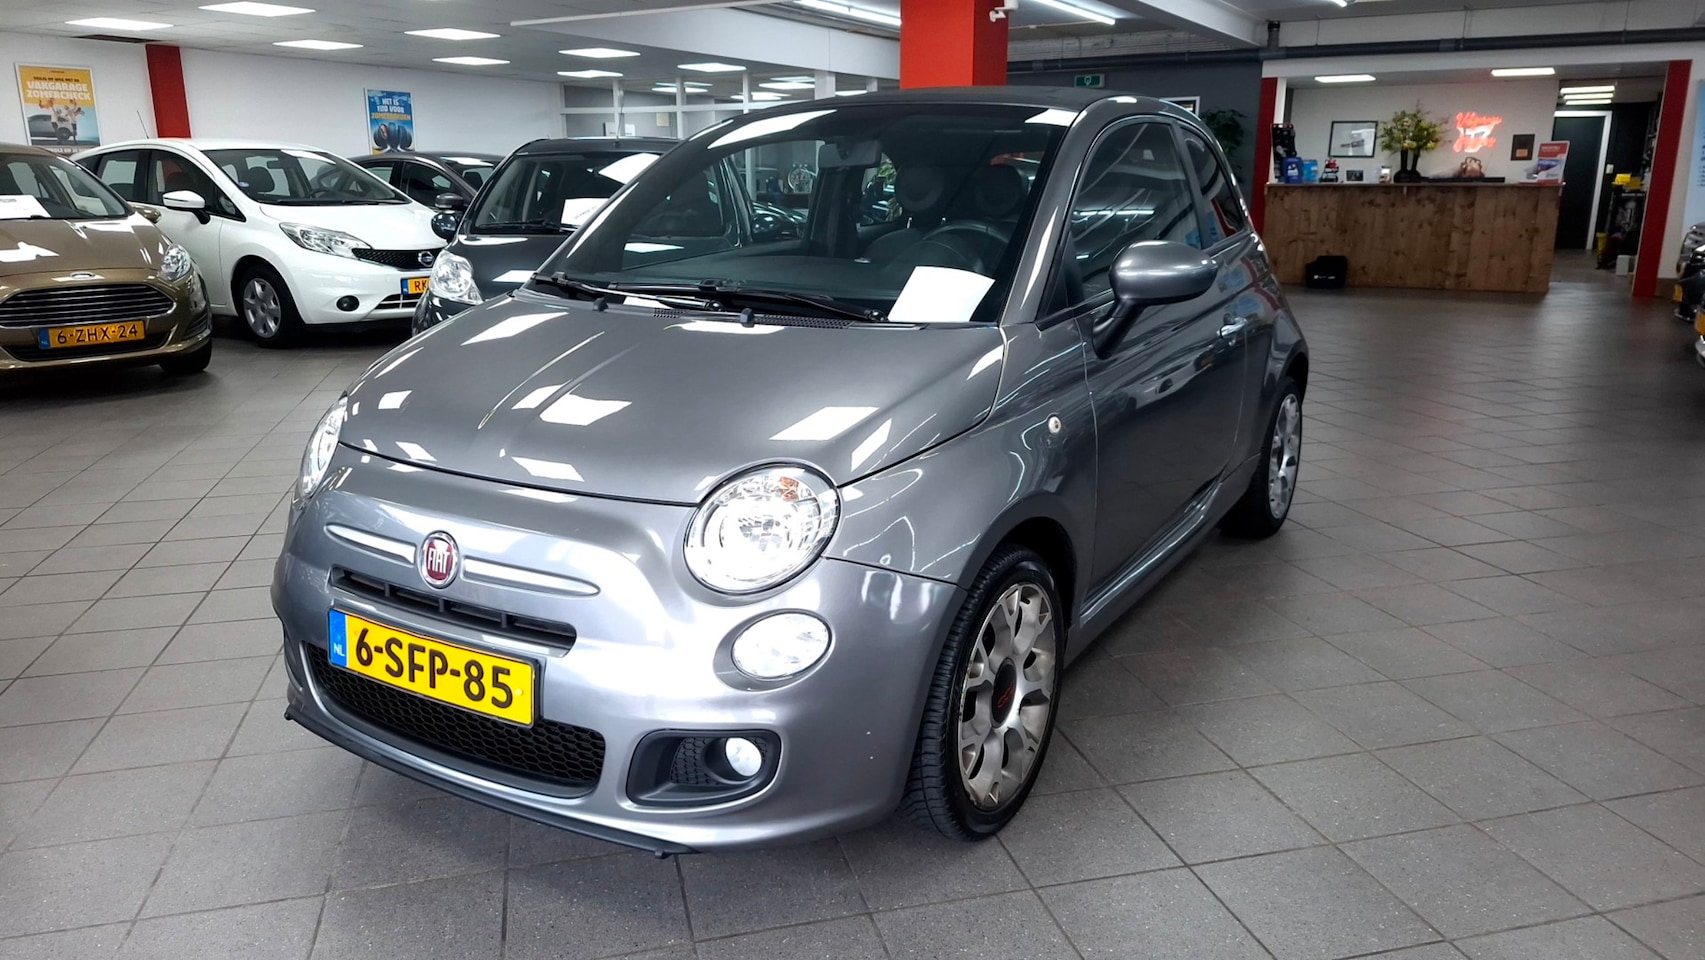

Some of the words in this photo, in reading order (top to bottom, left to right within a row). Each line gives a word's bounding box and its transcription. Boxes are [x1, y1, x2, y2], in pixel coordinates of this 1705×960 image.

[26, 80, 88, 93] VAKGARAGE
[26, 89, 91, 101] ZOMERCHECK
[381, 97, 392, 105] HET
[57, 323, 139, 345] 6-ZHX-24
[427, 549, 450, 574] FIAT
[333, 642, 346, 657] NL
[355, 627, 513, 710] 6-SFP-85
